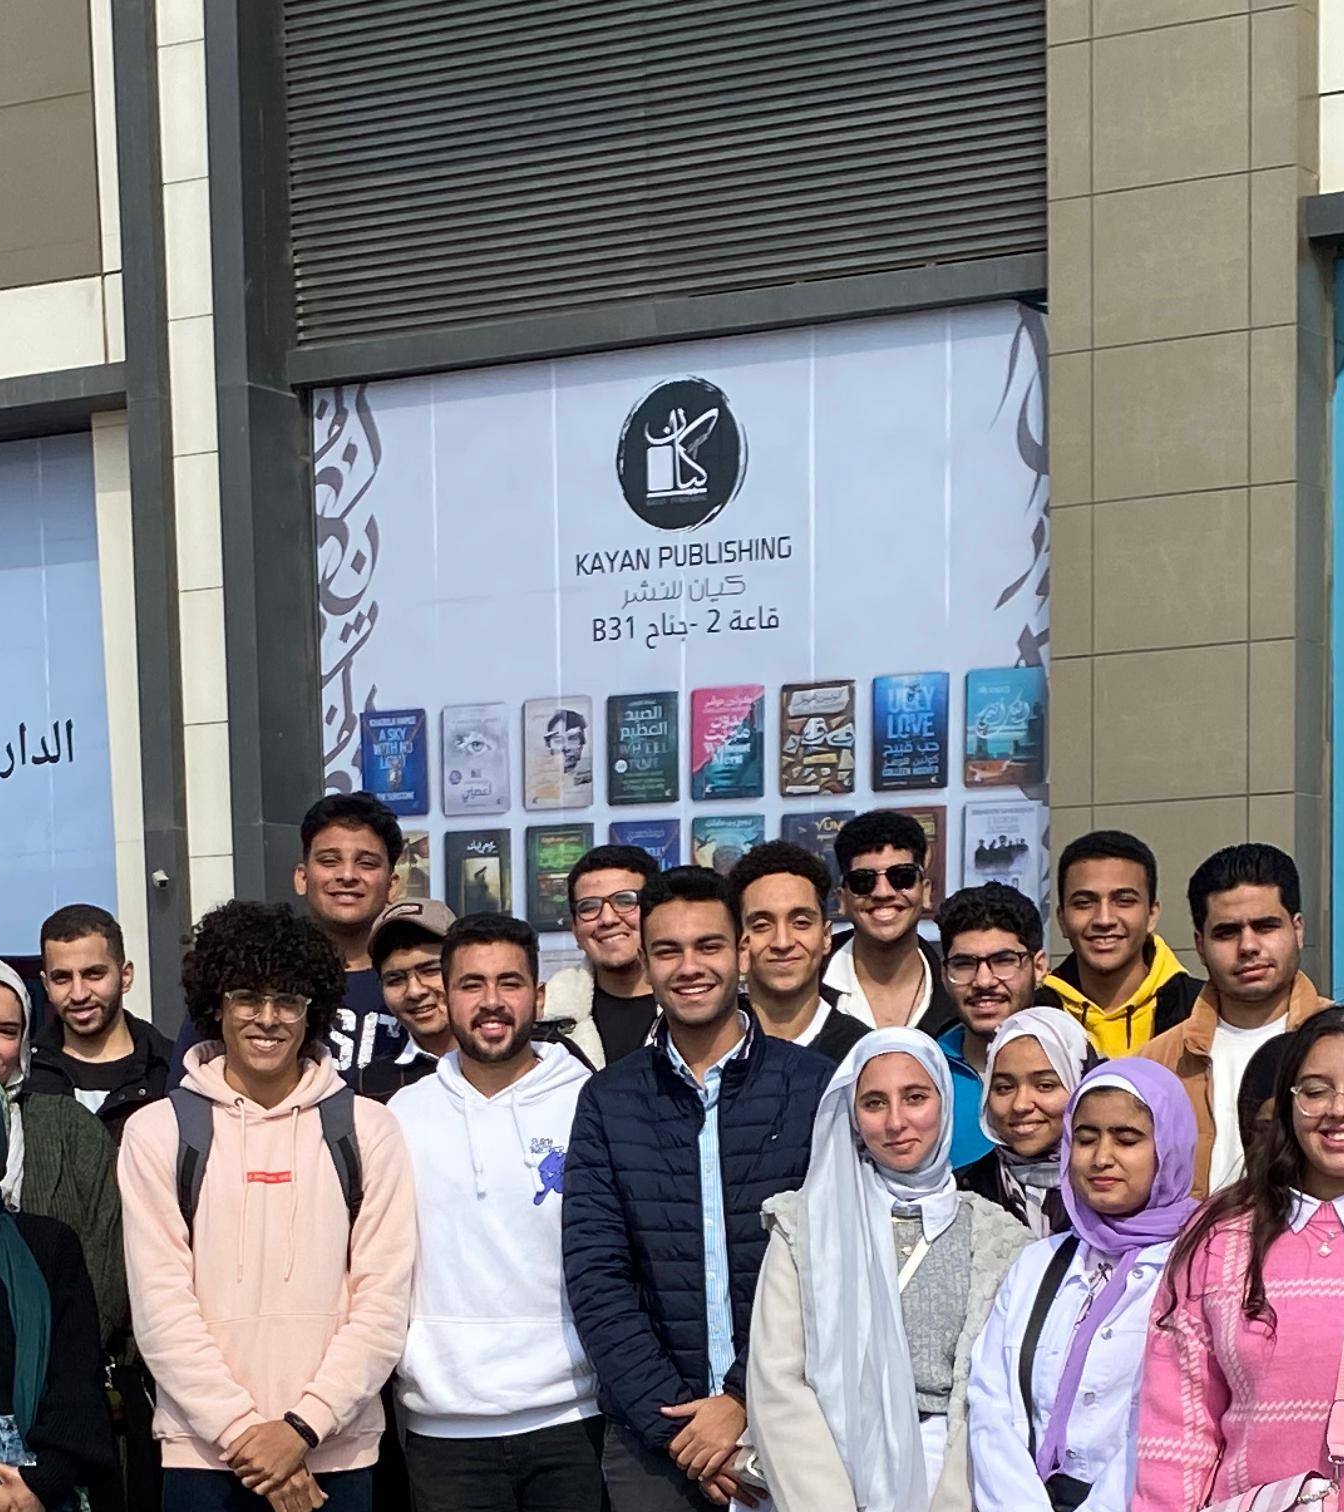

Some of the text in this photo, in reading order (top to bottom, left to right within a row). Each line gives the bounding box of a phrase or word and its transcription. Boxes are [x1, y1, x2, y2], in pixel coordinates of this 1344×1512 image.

[575, 536, 793, 577] KAYAN PUBLISHING
[621, 574, 747, 610] كيان للنشر
[592, 616, 635, 642] B31
[707, 608, 722, 633] 2
[729, 605, 780, 632] قاعة
[887, 712, 936, 740] LOVE
